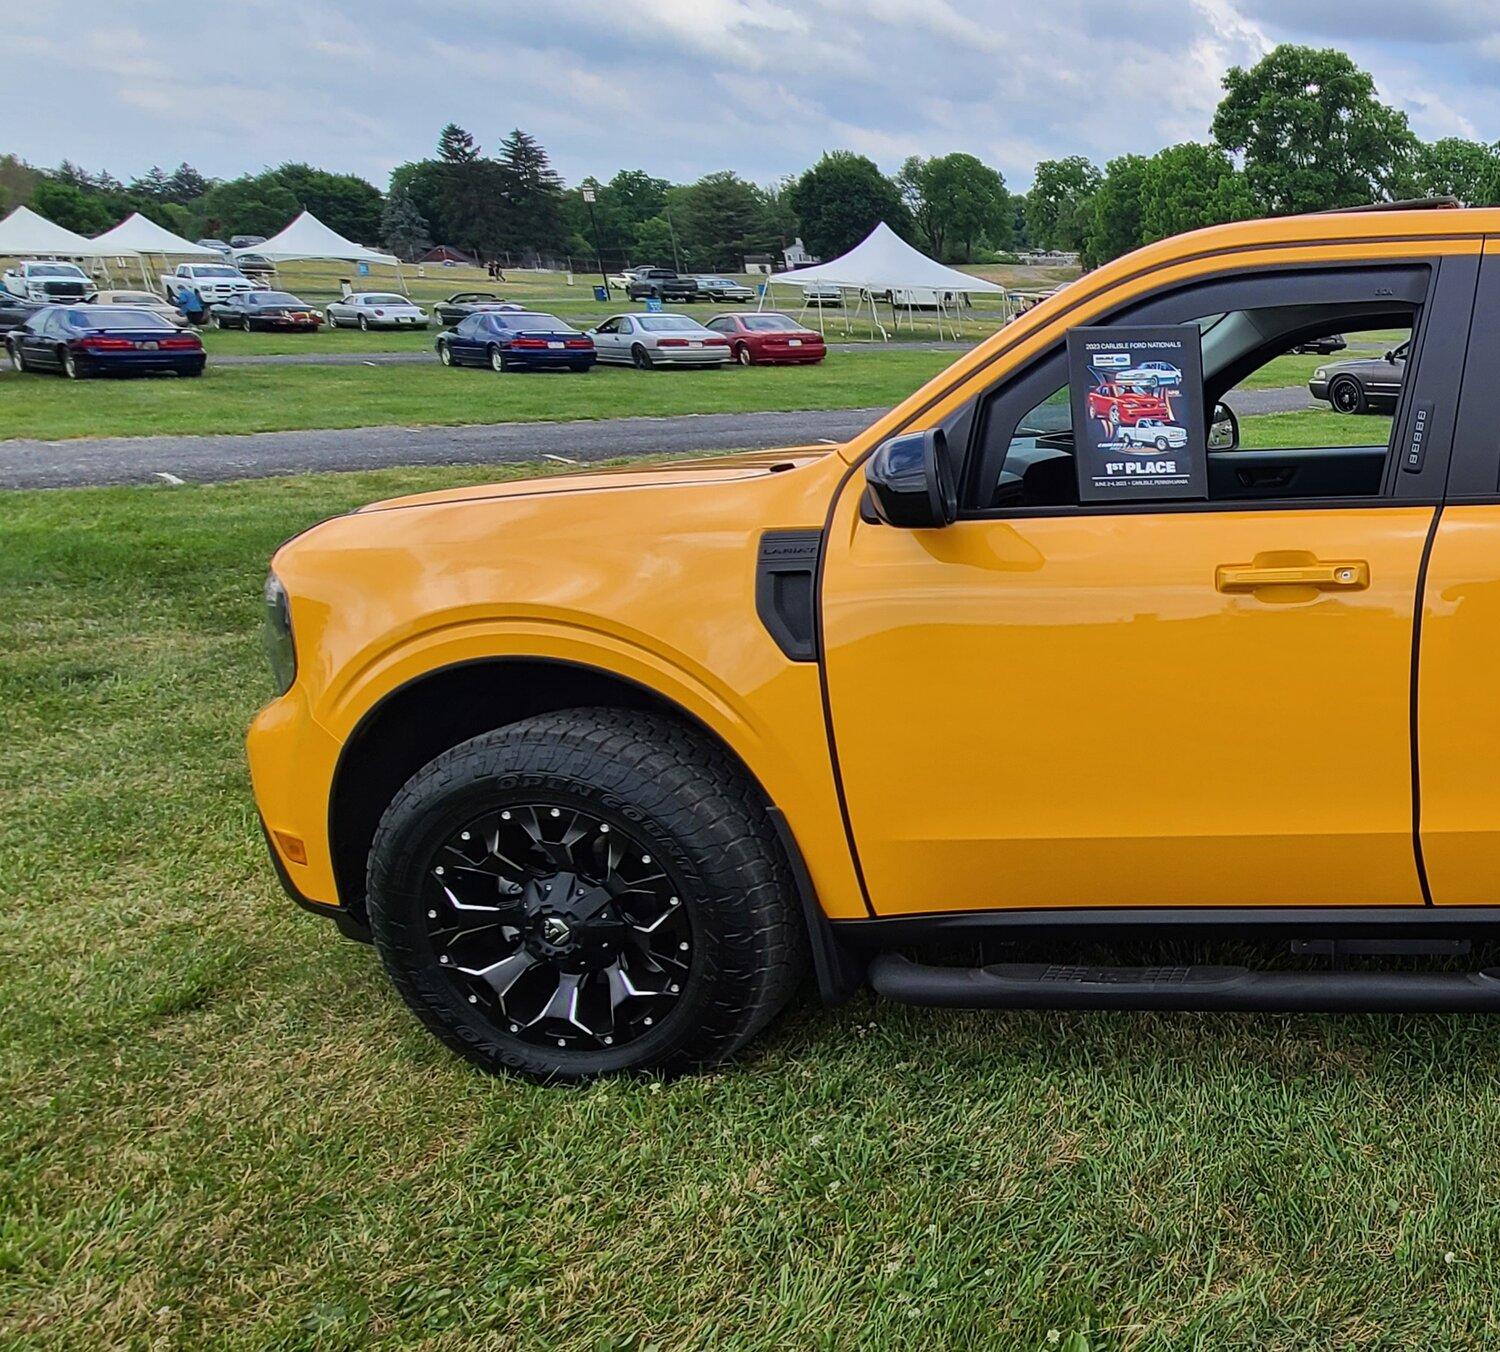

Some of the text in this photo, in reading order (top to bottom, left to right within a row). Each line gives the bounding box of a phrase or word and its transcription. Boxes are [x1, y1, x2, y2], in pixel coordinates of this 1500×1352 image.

[1105, 461, 1177, 474] 1ST PLACE
[499, 774, 591, 797] OPEN
